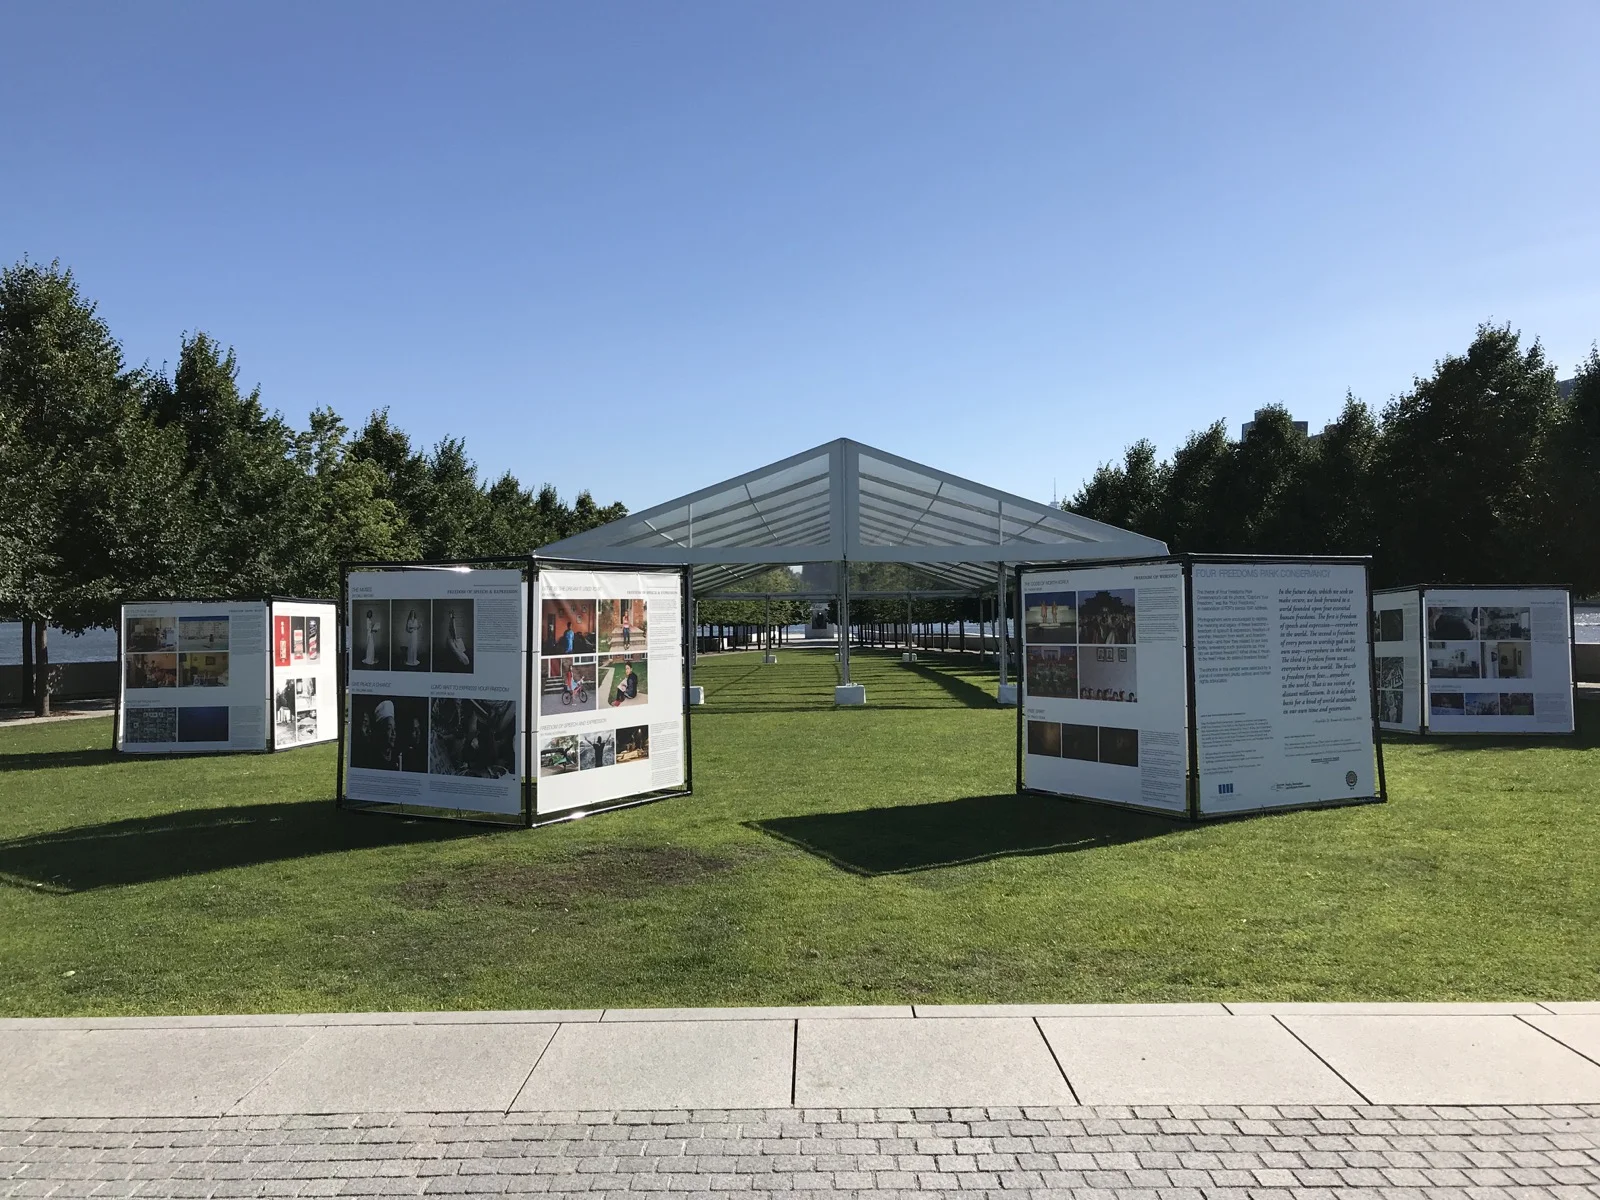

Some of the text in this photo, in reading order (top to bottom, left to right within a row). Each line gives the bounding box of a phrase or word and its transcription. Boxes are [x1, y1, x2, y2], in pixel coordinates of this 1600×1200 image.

[1196, 569, 1331, 578] FOUR FREEDOMS PARK CONSERVANCY
